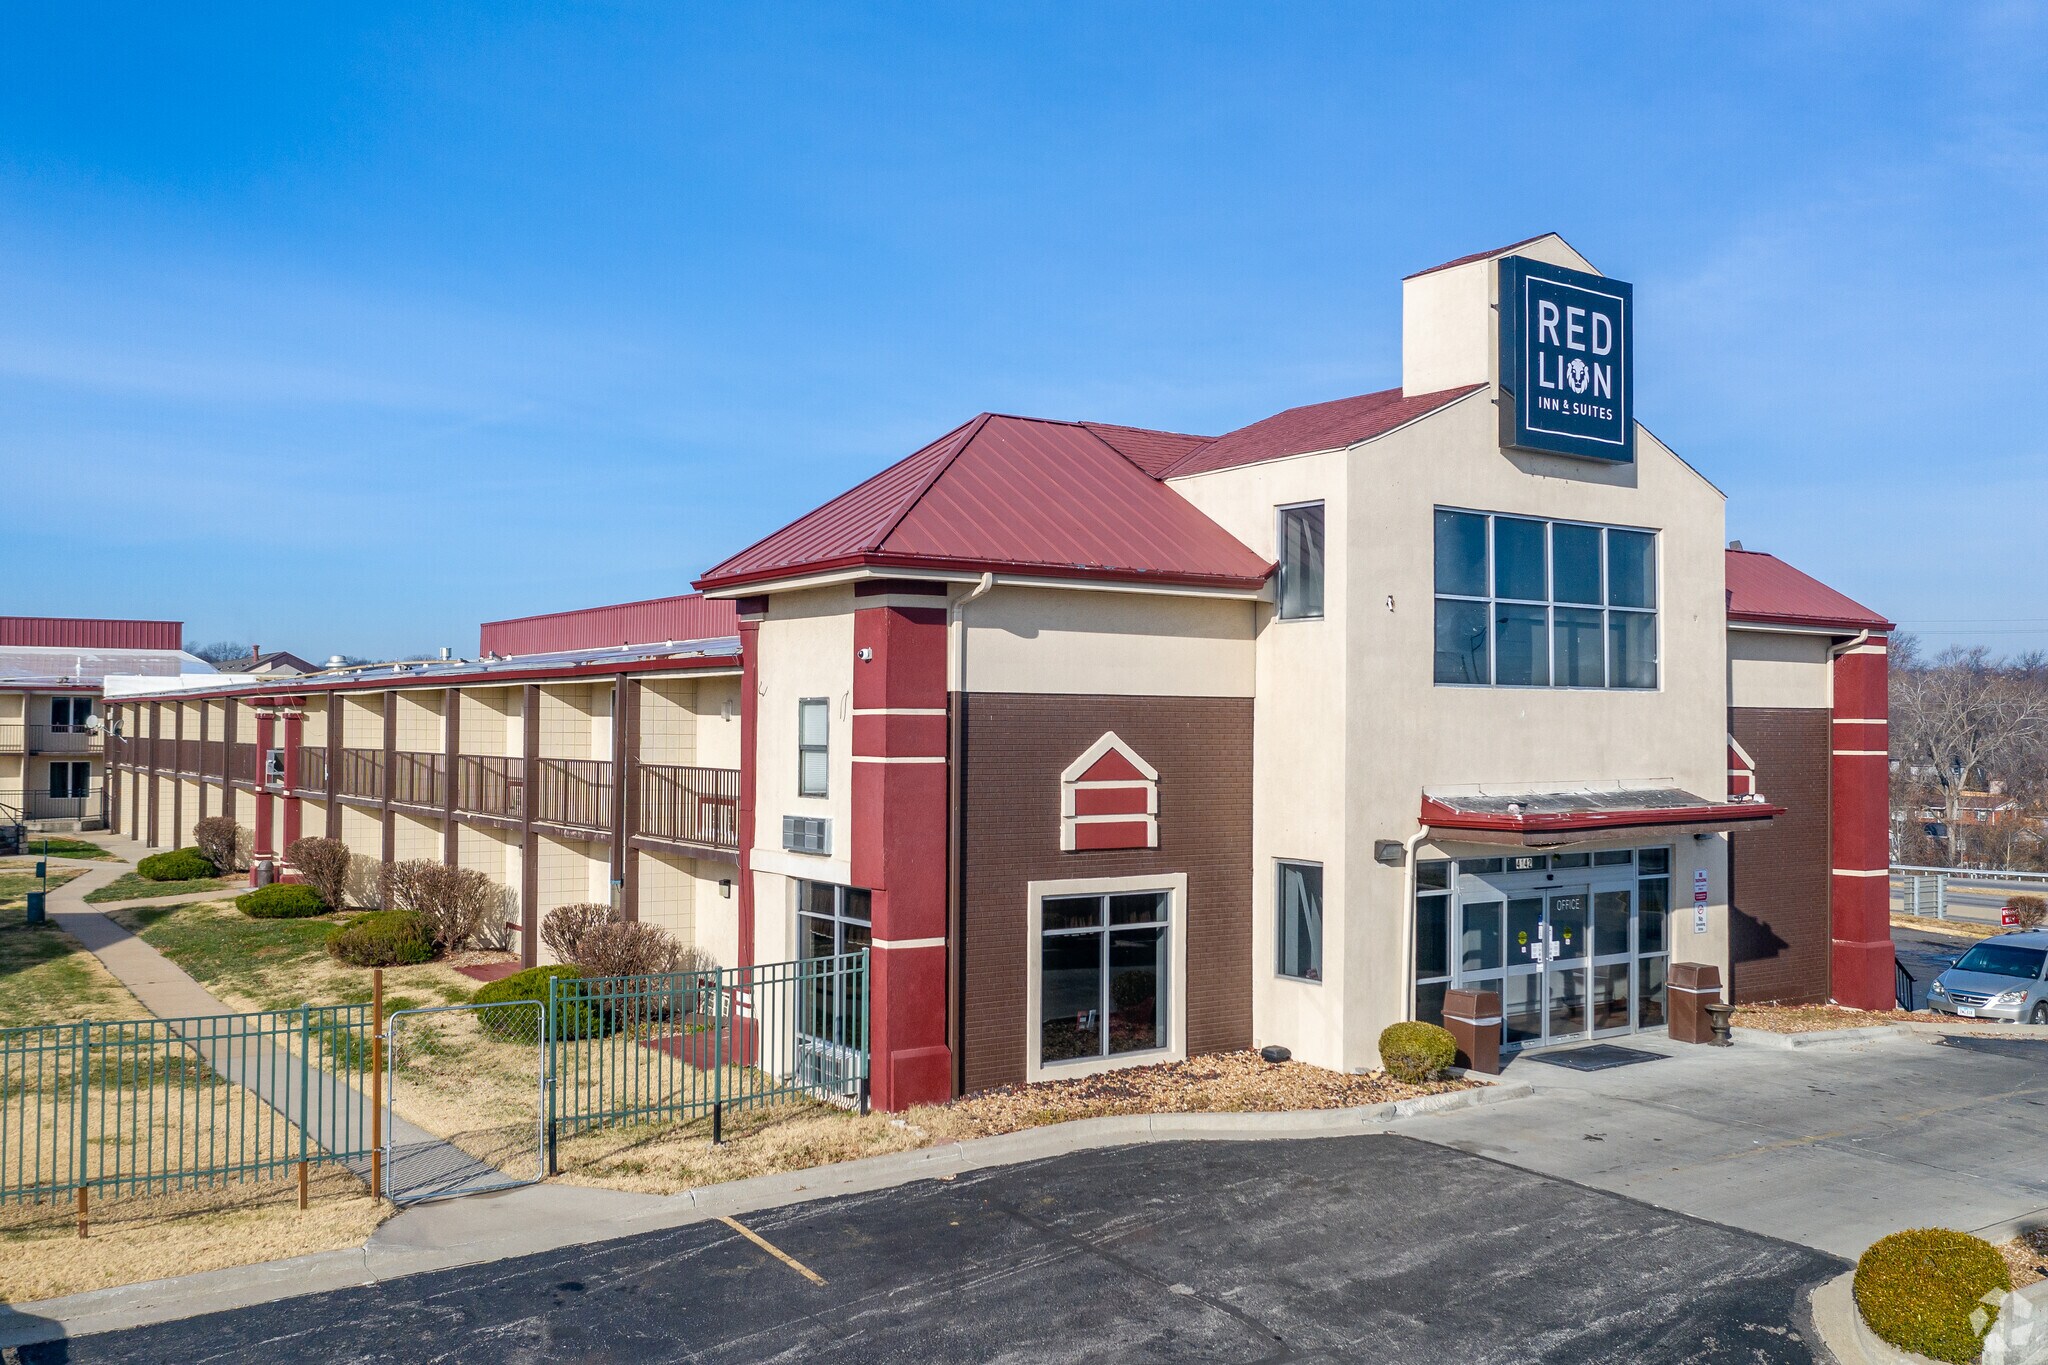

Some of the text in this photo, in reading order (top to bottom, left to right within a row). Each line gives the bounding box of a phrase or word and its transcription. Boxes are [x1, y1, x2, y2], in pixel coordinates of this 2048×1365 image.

[1538, 299, 1613, 355] RED
[1538, 396, 1613, 420] INN & SUITES
[1556, 898, 1580, 911] OFFICE
